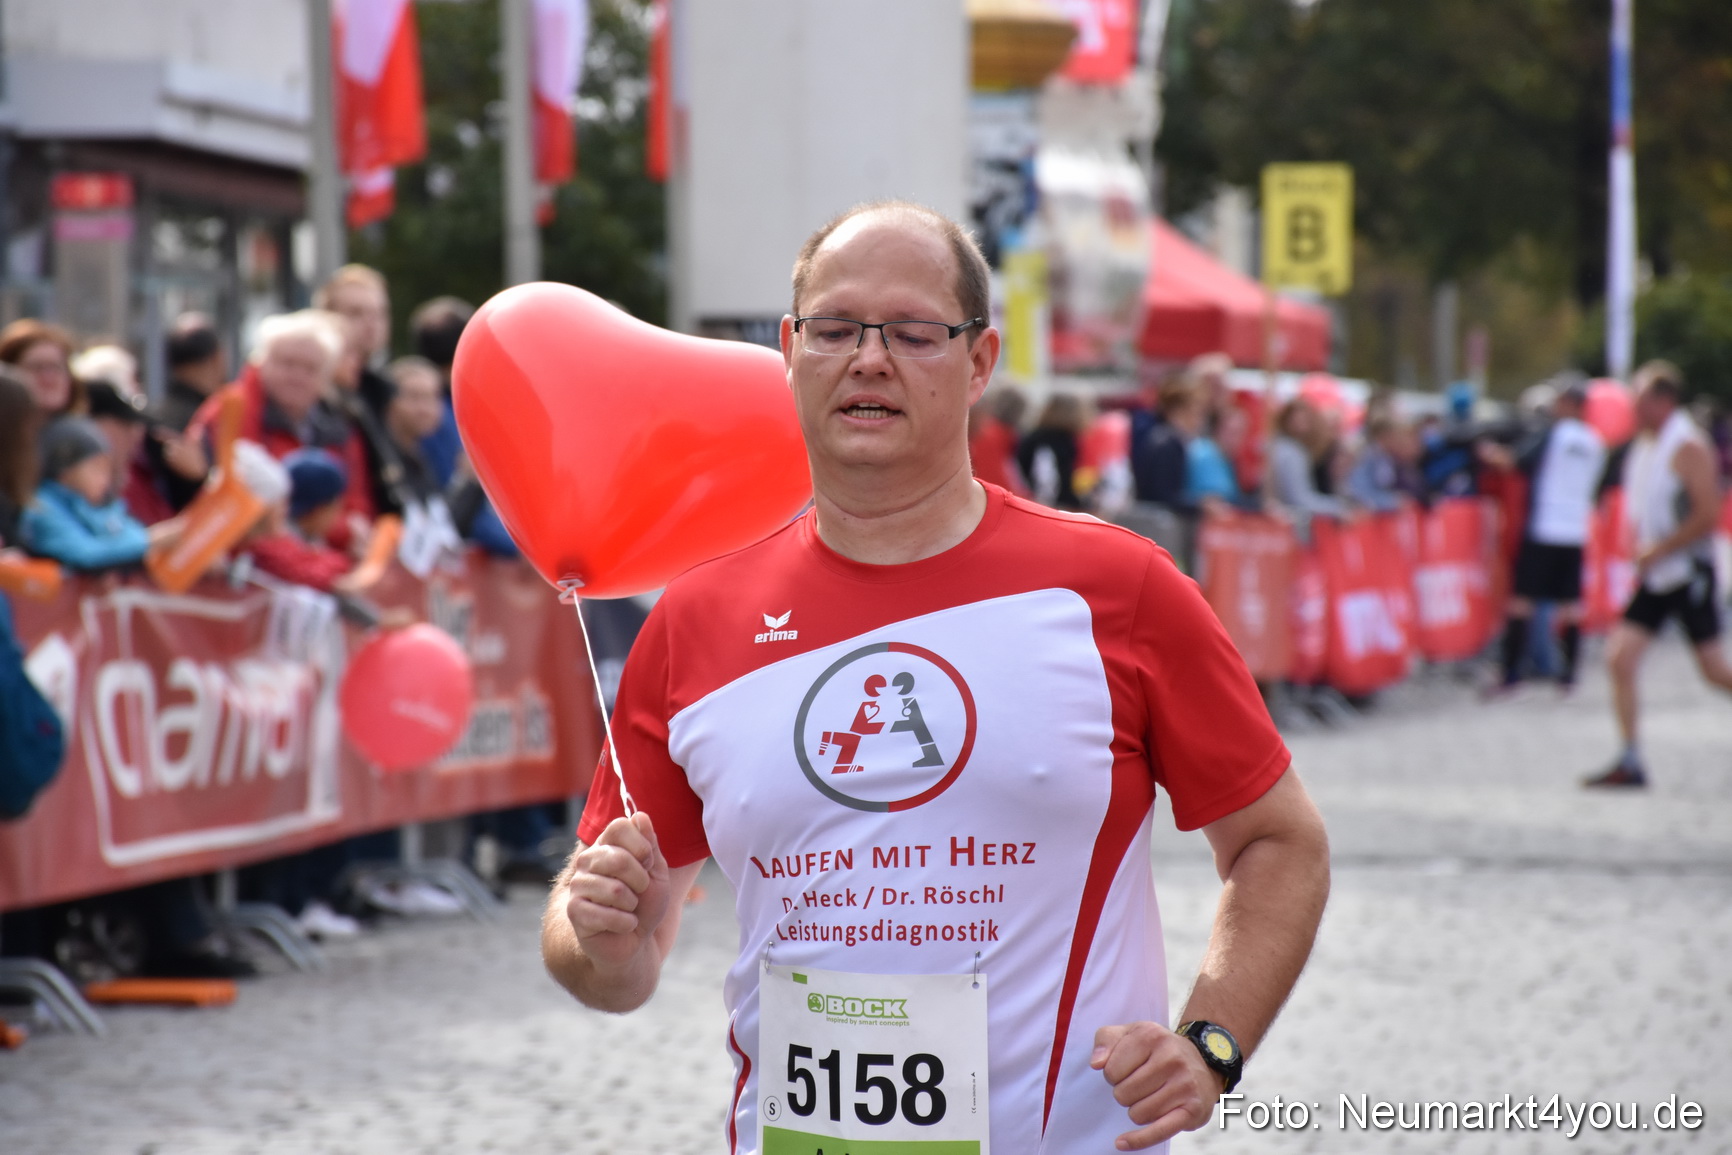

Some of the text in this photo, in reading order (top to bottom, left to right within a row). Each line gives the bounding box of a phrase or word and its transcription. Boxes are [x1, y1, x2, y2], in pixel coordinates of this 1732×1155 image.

[1285, 203, 1327, 264] B
[754, 628, 798, 643] erima
[750, 836, 1036, 879] LAUFEN MIT HERZ
[803, 890, 857, 907] Heck
[882, 887, 915, 905] Dr.
[924, 884, 1004, 904] Röschl
[776, 918, 999, 947] Leistungsdiagnostik
[826, 994, 909, 1018] BOCK
[826, 1015, 911, 1028] inspired by smart concepts
[786, 1043, 947, 1126] 5158
[768, 1102, 776, 1116] S
